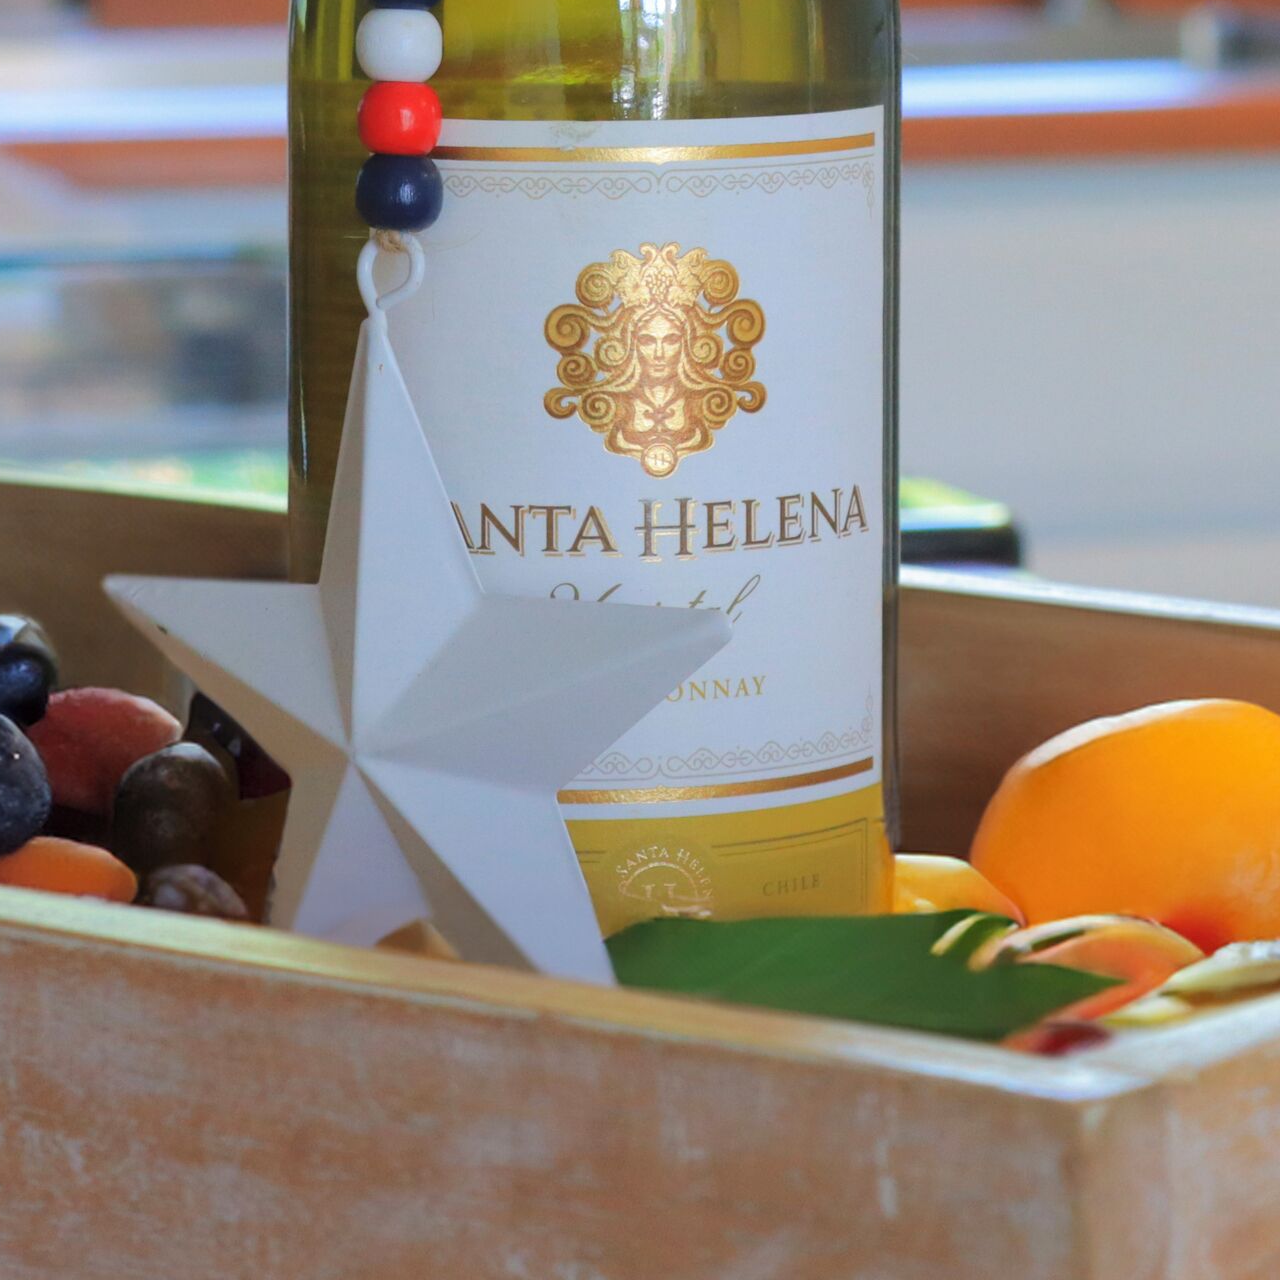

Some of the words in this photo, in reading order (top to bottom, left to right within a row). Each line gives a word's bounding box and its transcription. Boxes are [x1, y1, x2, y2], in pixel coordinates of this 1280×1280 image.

[634, 483, 869, 563] HELENA
[615, 845, 670, 879] SANTA
[762, 872, 821, 897] CHILE
